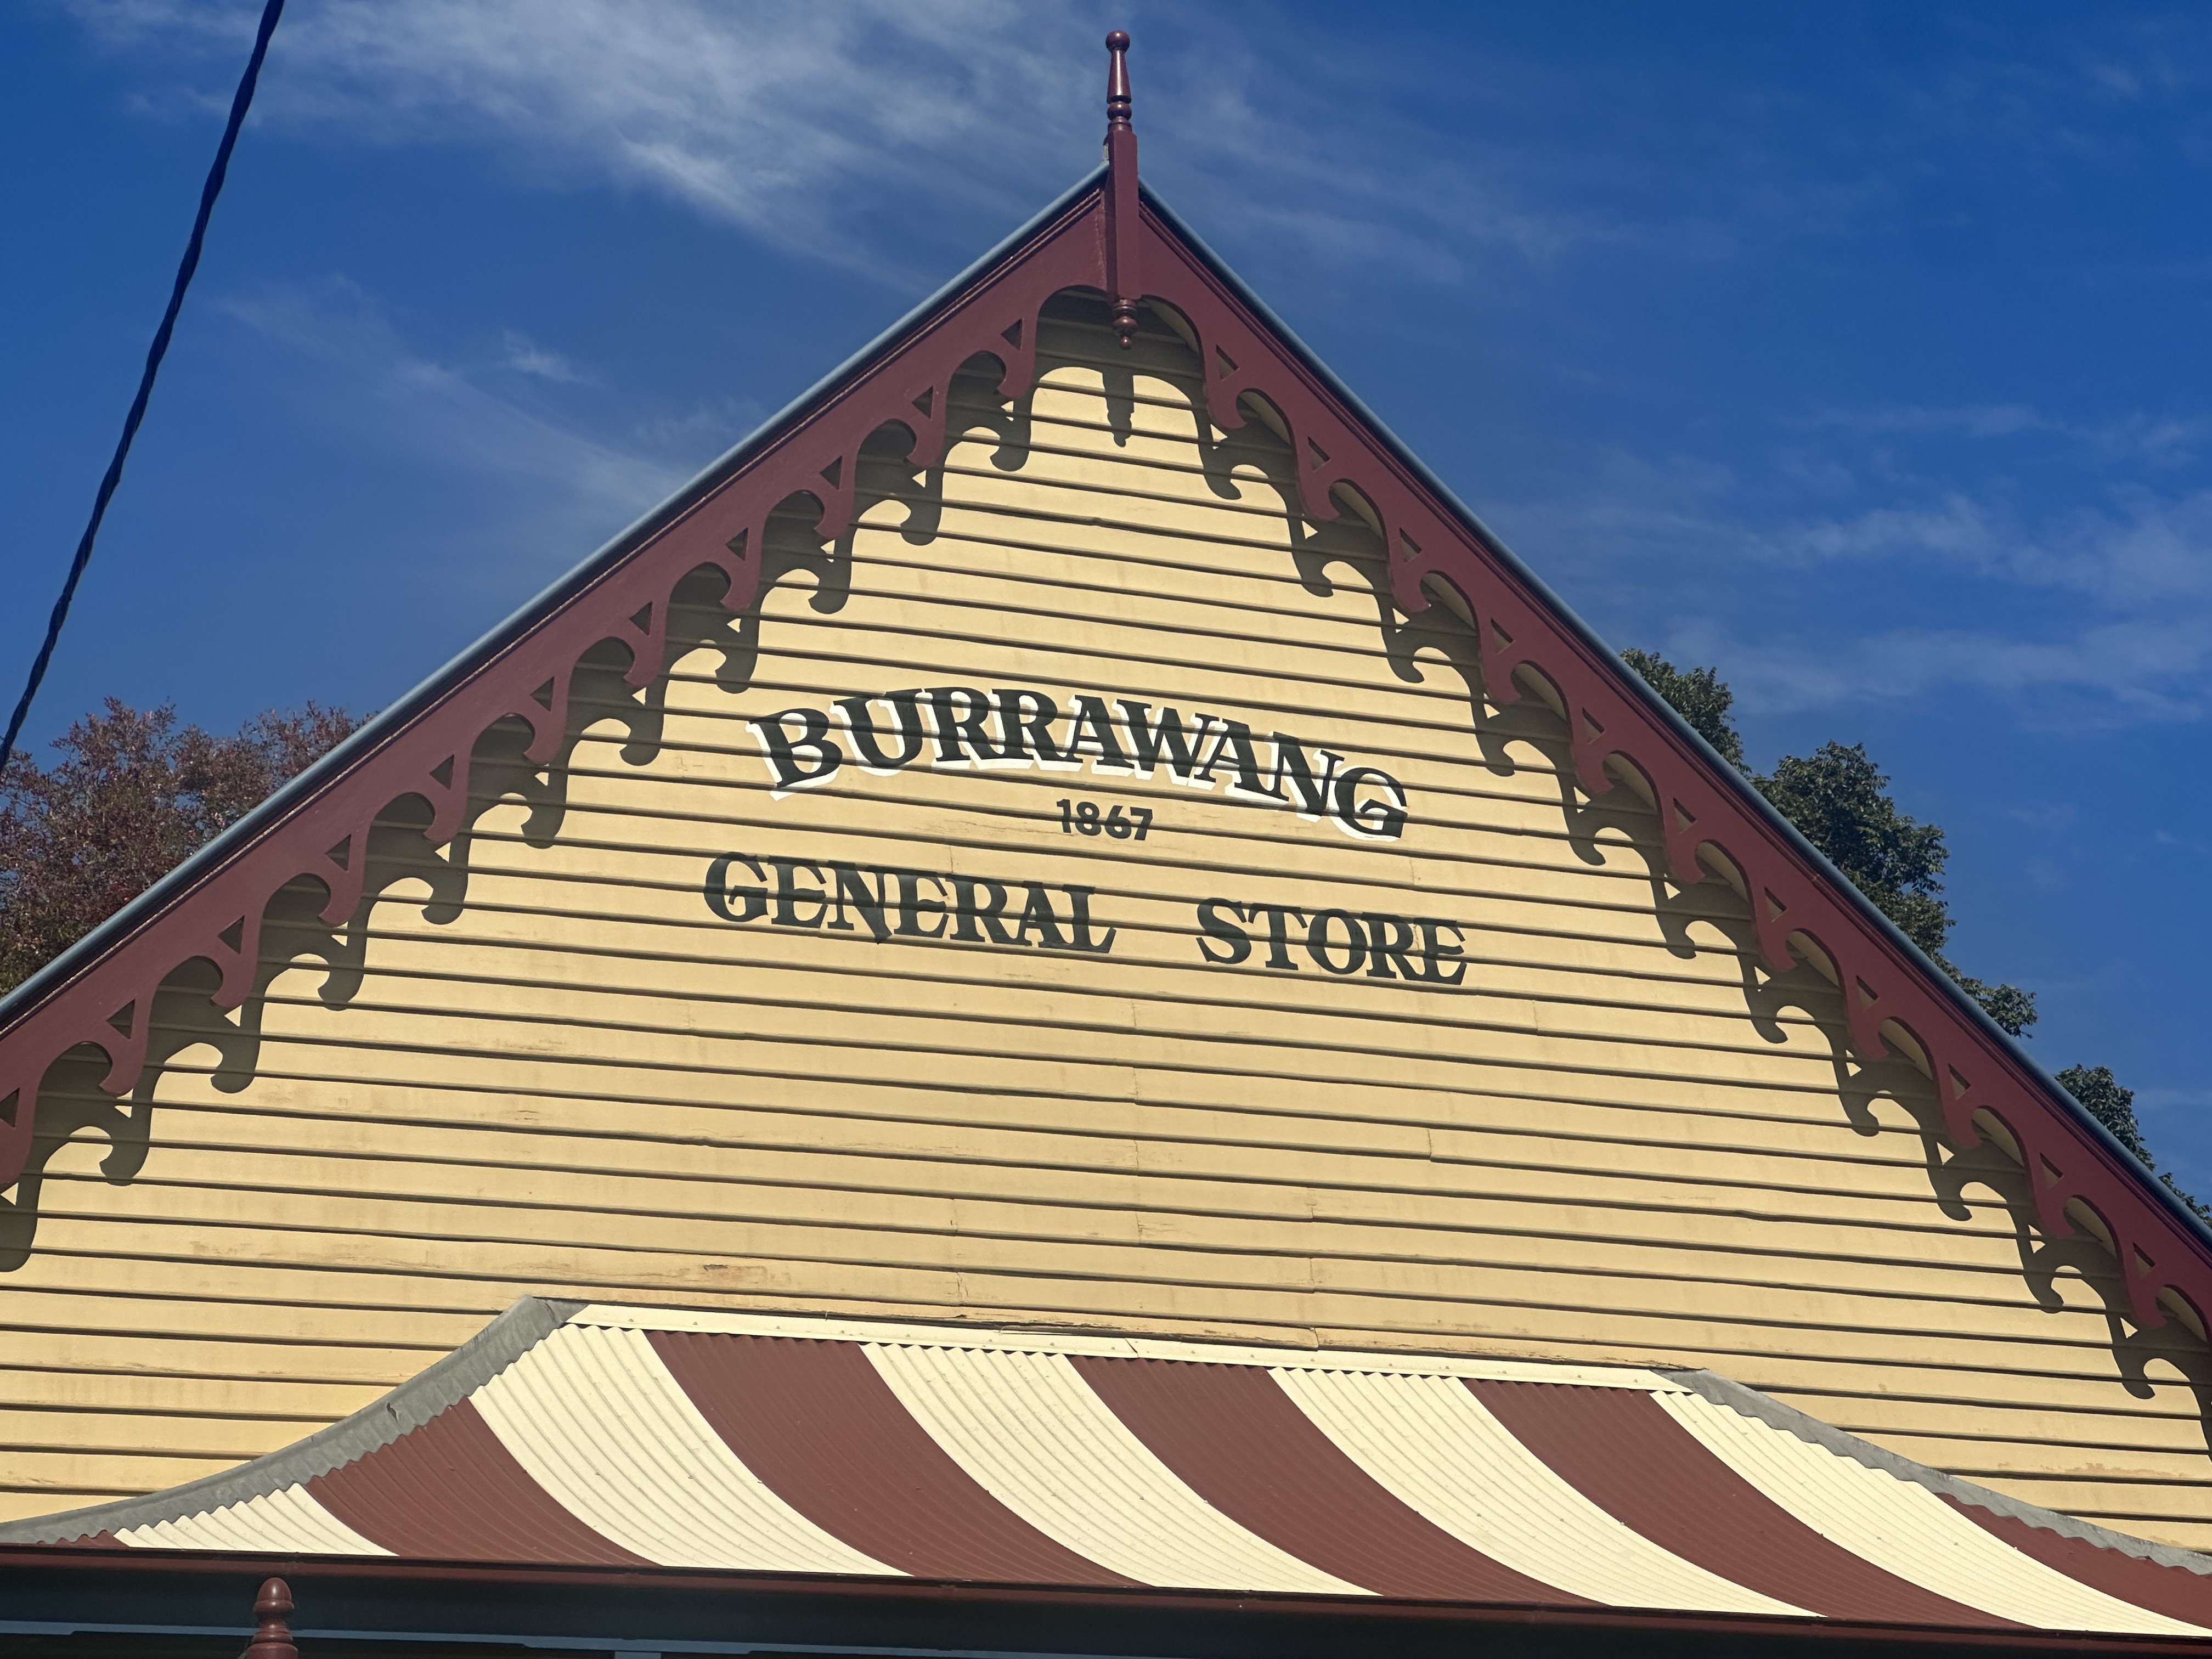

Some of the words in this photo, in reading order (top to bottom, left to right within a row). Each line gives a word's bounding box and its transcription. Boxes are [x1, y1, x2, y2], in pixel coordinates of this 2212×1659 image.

[746, 687, 1408, 841] BURRAWANG
[1057, 799, 1153, 840] 1867
[703, 852, 1116, 953] GENERAL
[1196, 898, 1468, 985] STORE
